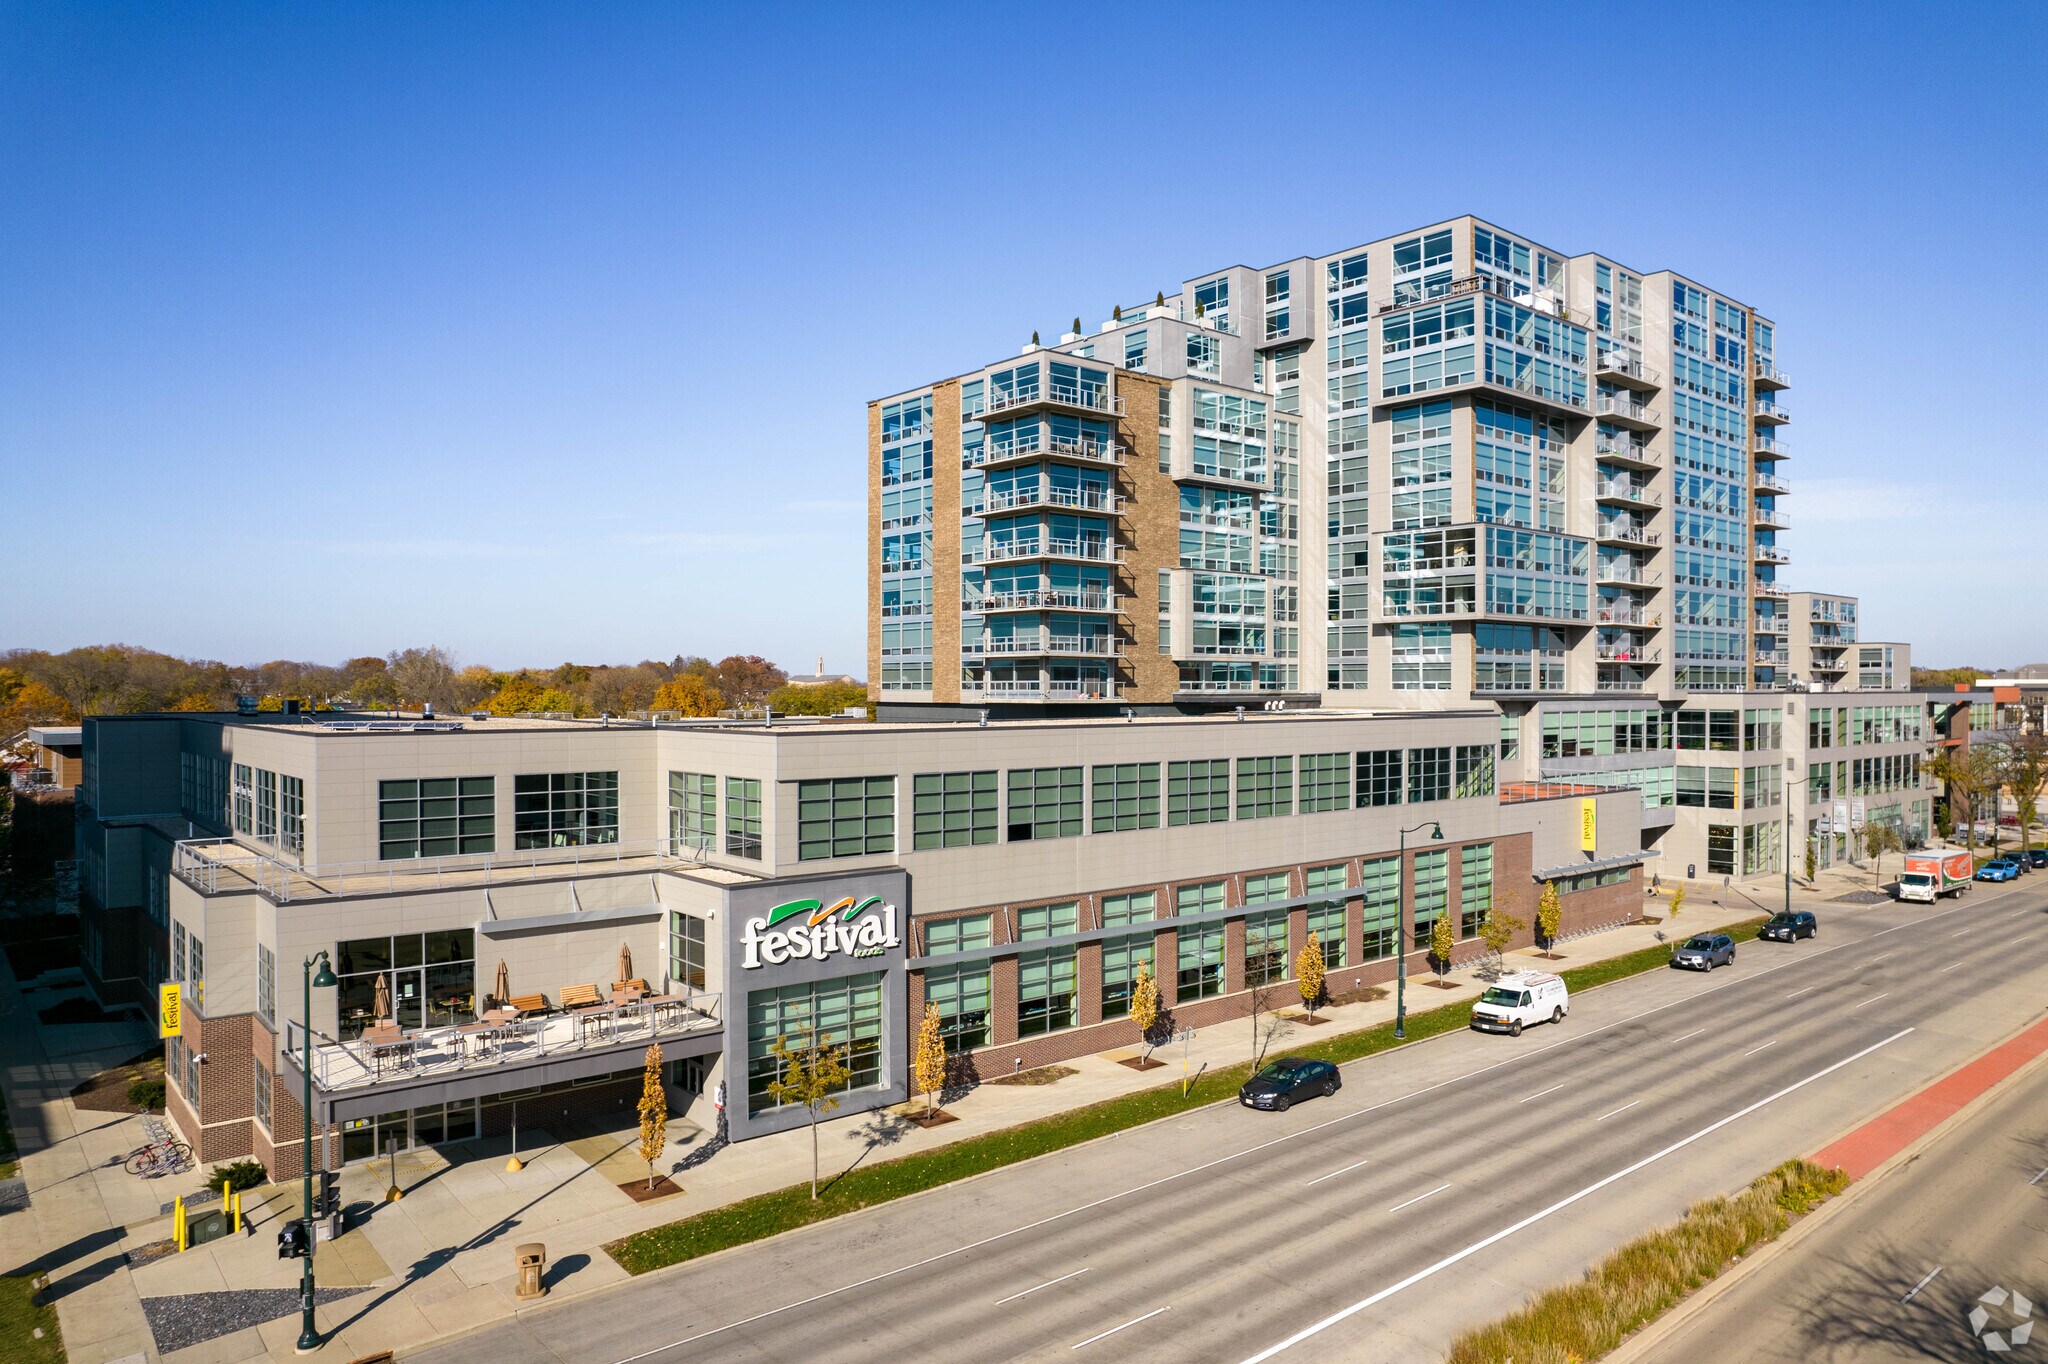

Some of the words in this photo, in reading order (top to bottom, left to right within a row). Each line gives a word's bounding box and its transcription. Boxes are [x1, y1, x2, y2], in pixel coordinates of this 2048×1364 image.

[1583, 808, 1593, 840] festival
[740, 905, 900, 969] festival
[853, 946, 884, 958] foods
[166, 992, 178, 1029] festival
